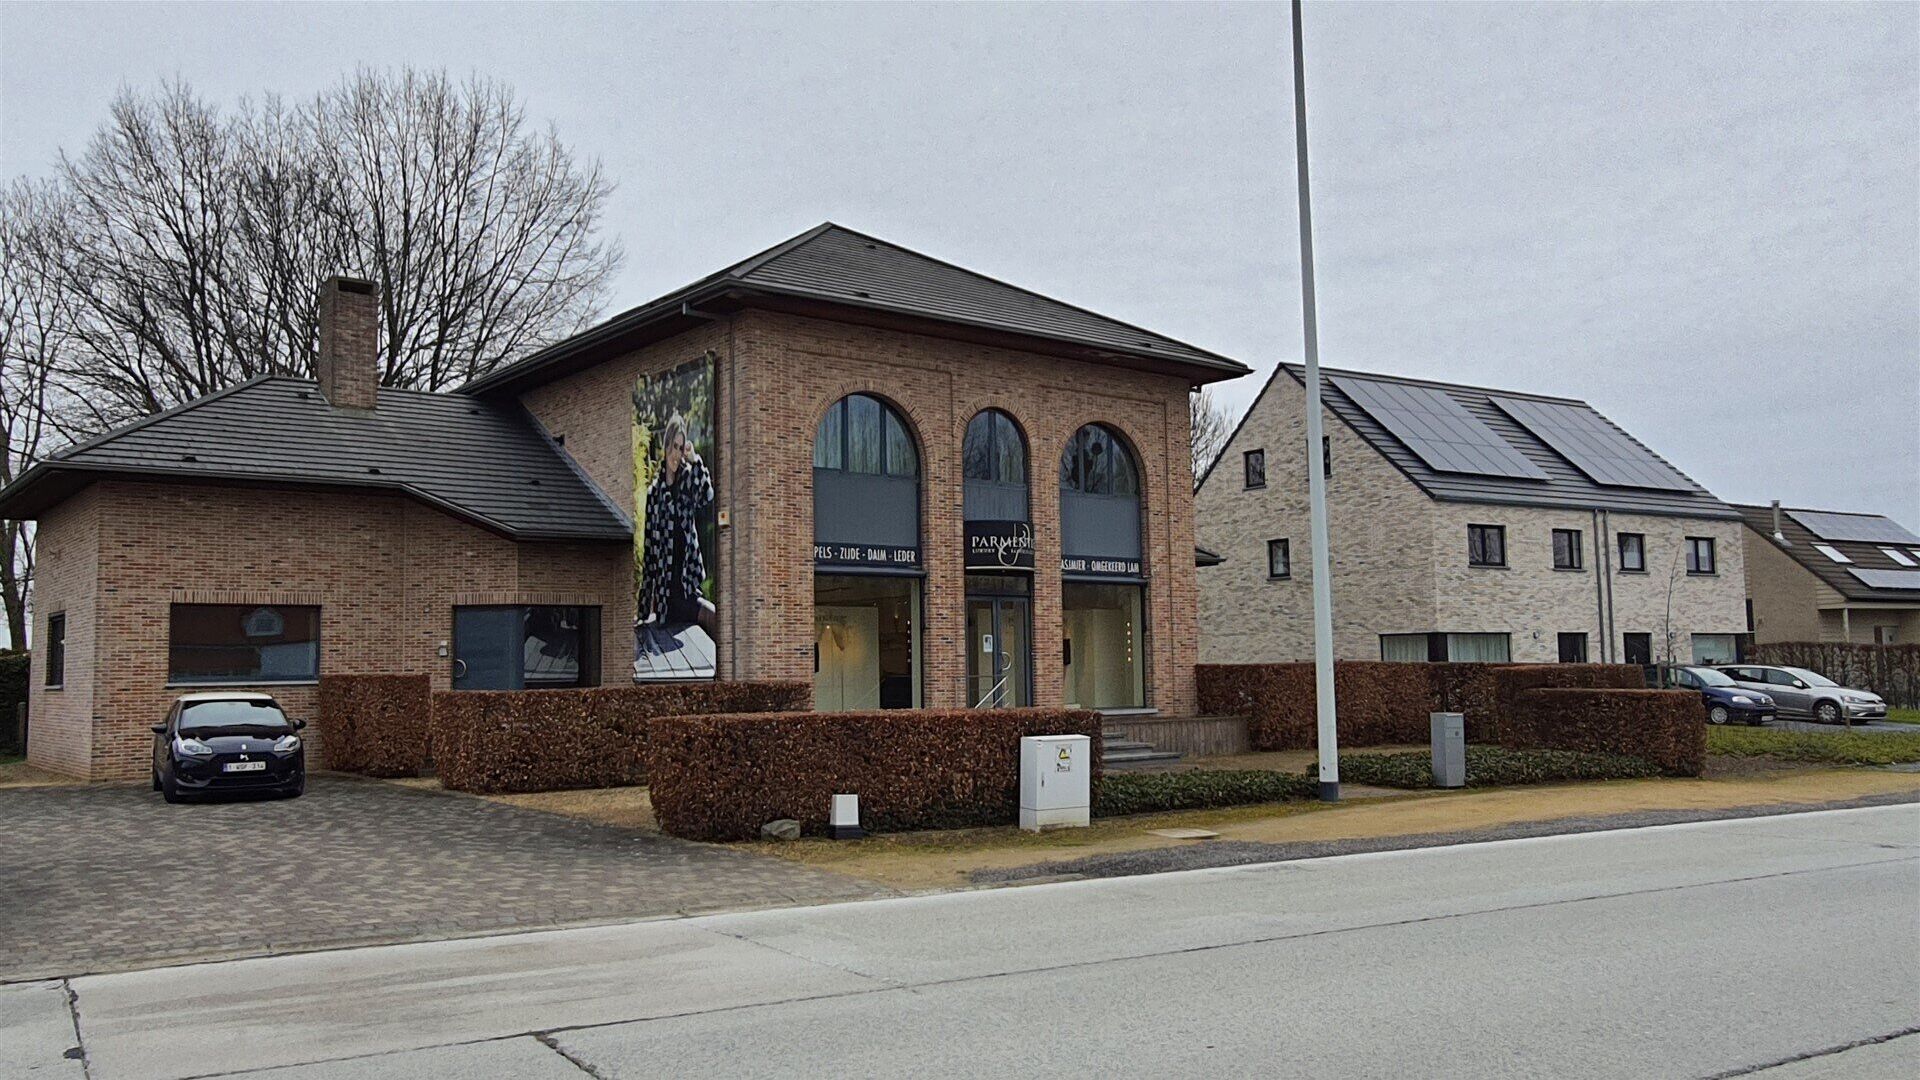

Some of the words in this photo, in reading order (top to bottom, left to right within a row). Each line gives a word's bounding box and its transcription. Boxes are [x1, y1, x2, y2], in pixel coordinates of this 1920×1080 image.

[814, 546, 833, 559] PELS
[840, 547, 860, 560] ZIJDE
[893, 549, 916, 562] LEDER
